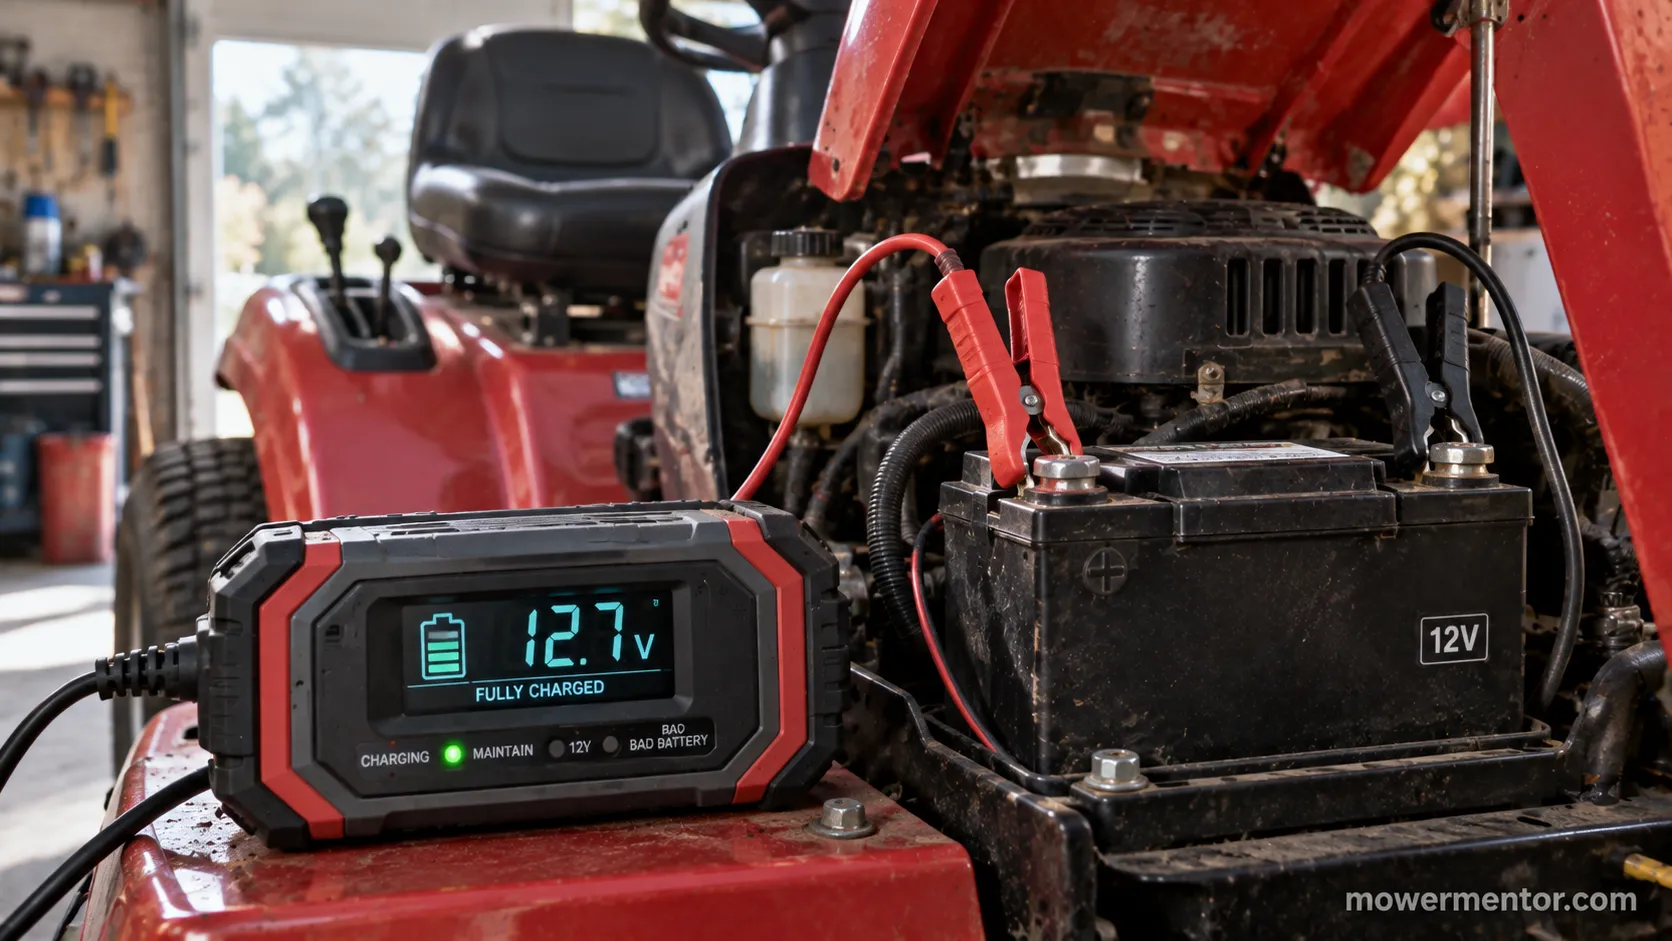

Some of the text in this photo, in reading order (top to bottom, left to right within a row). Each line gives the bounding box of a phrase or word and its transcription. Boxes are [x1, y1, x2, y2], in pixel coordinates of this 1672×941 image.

[525, 601, 624, 668] 12.7
[1430, 623, 1480, 654] 12V
[475, 679, 605, 703] FULLY CHARGED
[569, 740, 592, 754] 12Y
[629, 734, 709, 751] BAD BATTERY
[360, 750, 430, 768] CHARGING
[473, 744, 534, 760] MAINTAIN
